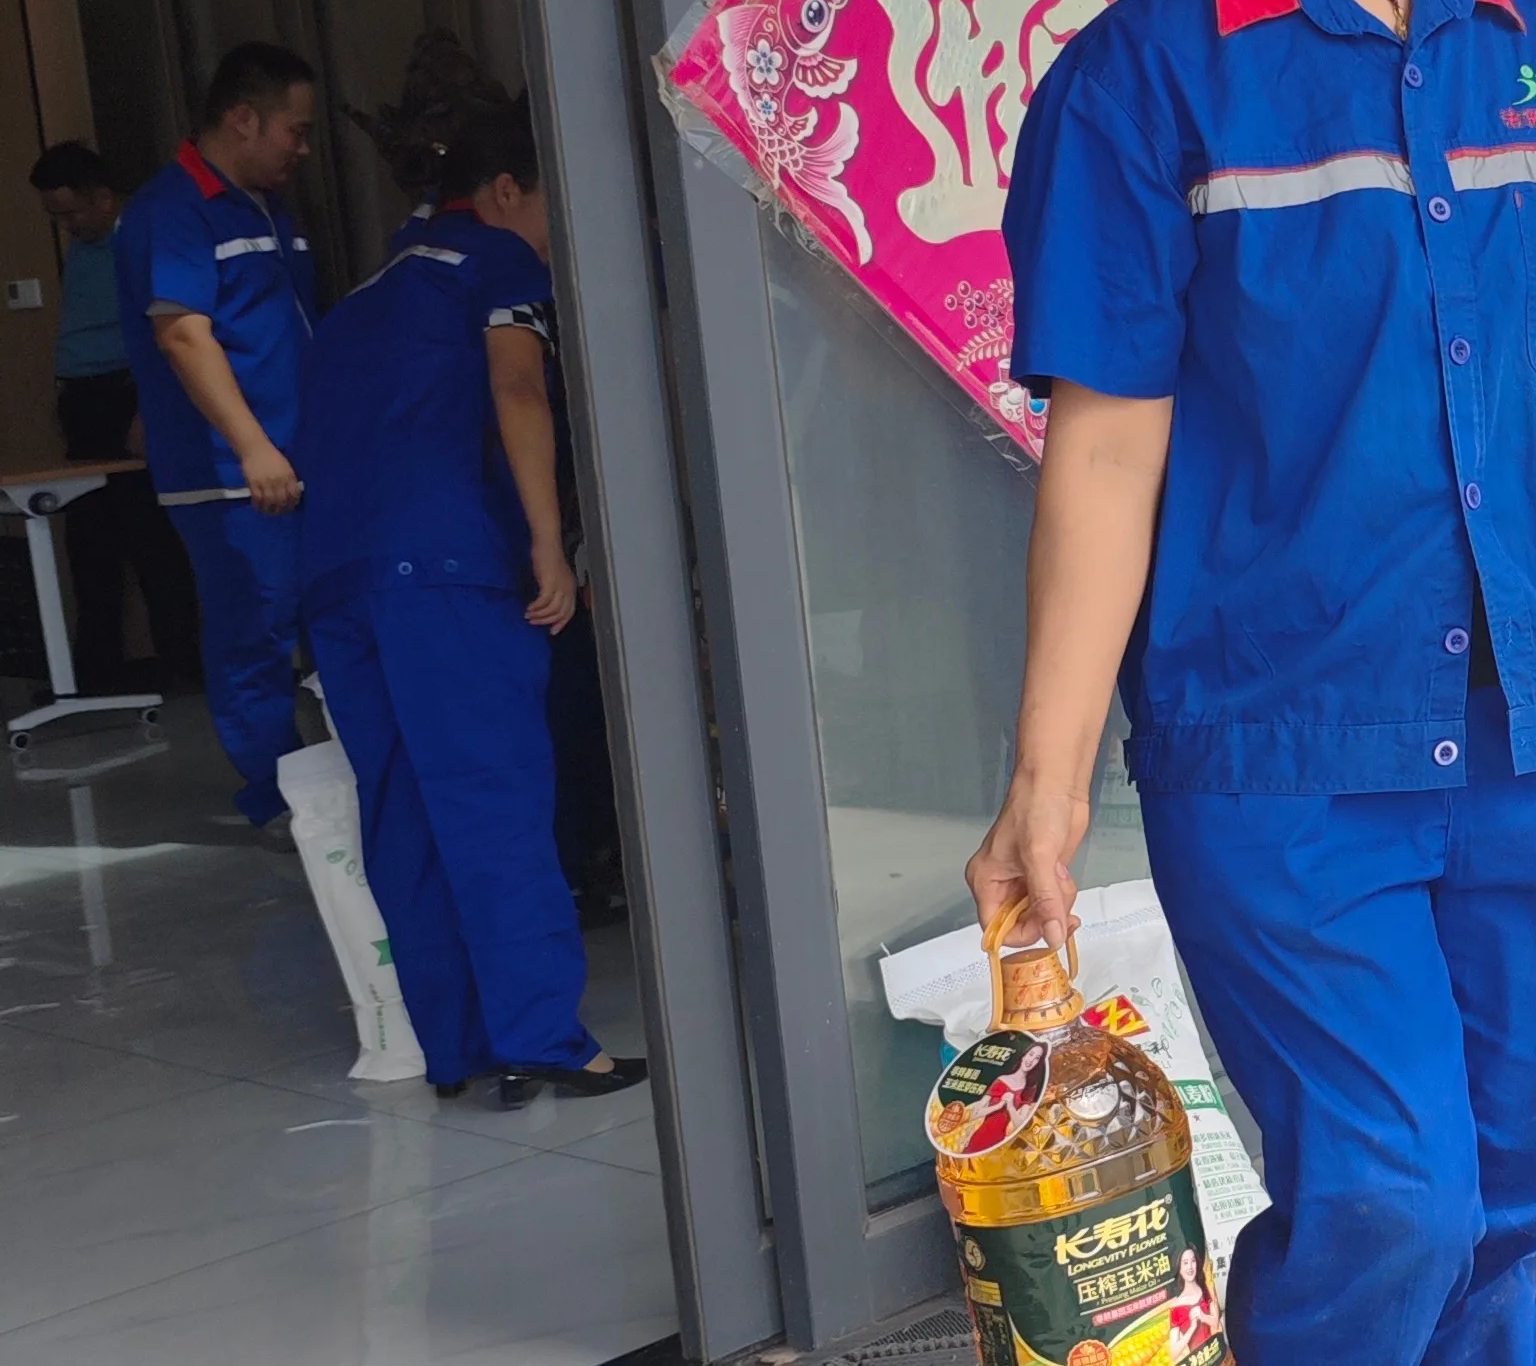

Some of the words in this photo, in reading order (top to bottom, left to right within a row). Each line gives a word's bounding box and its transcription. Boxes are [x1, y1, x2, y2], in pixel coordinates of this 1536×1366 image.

[1054, 1201, 1171, 1265] 长寿花
[1068, 1249, 1129, 1277] LONGEVITY
[1129, 1232, 1168, 1257] FLOWER
[1078, 1253, 1171, 1305] 压榨玉米油
